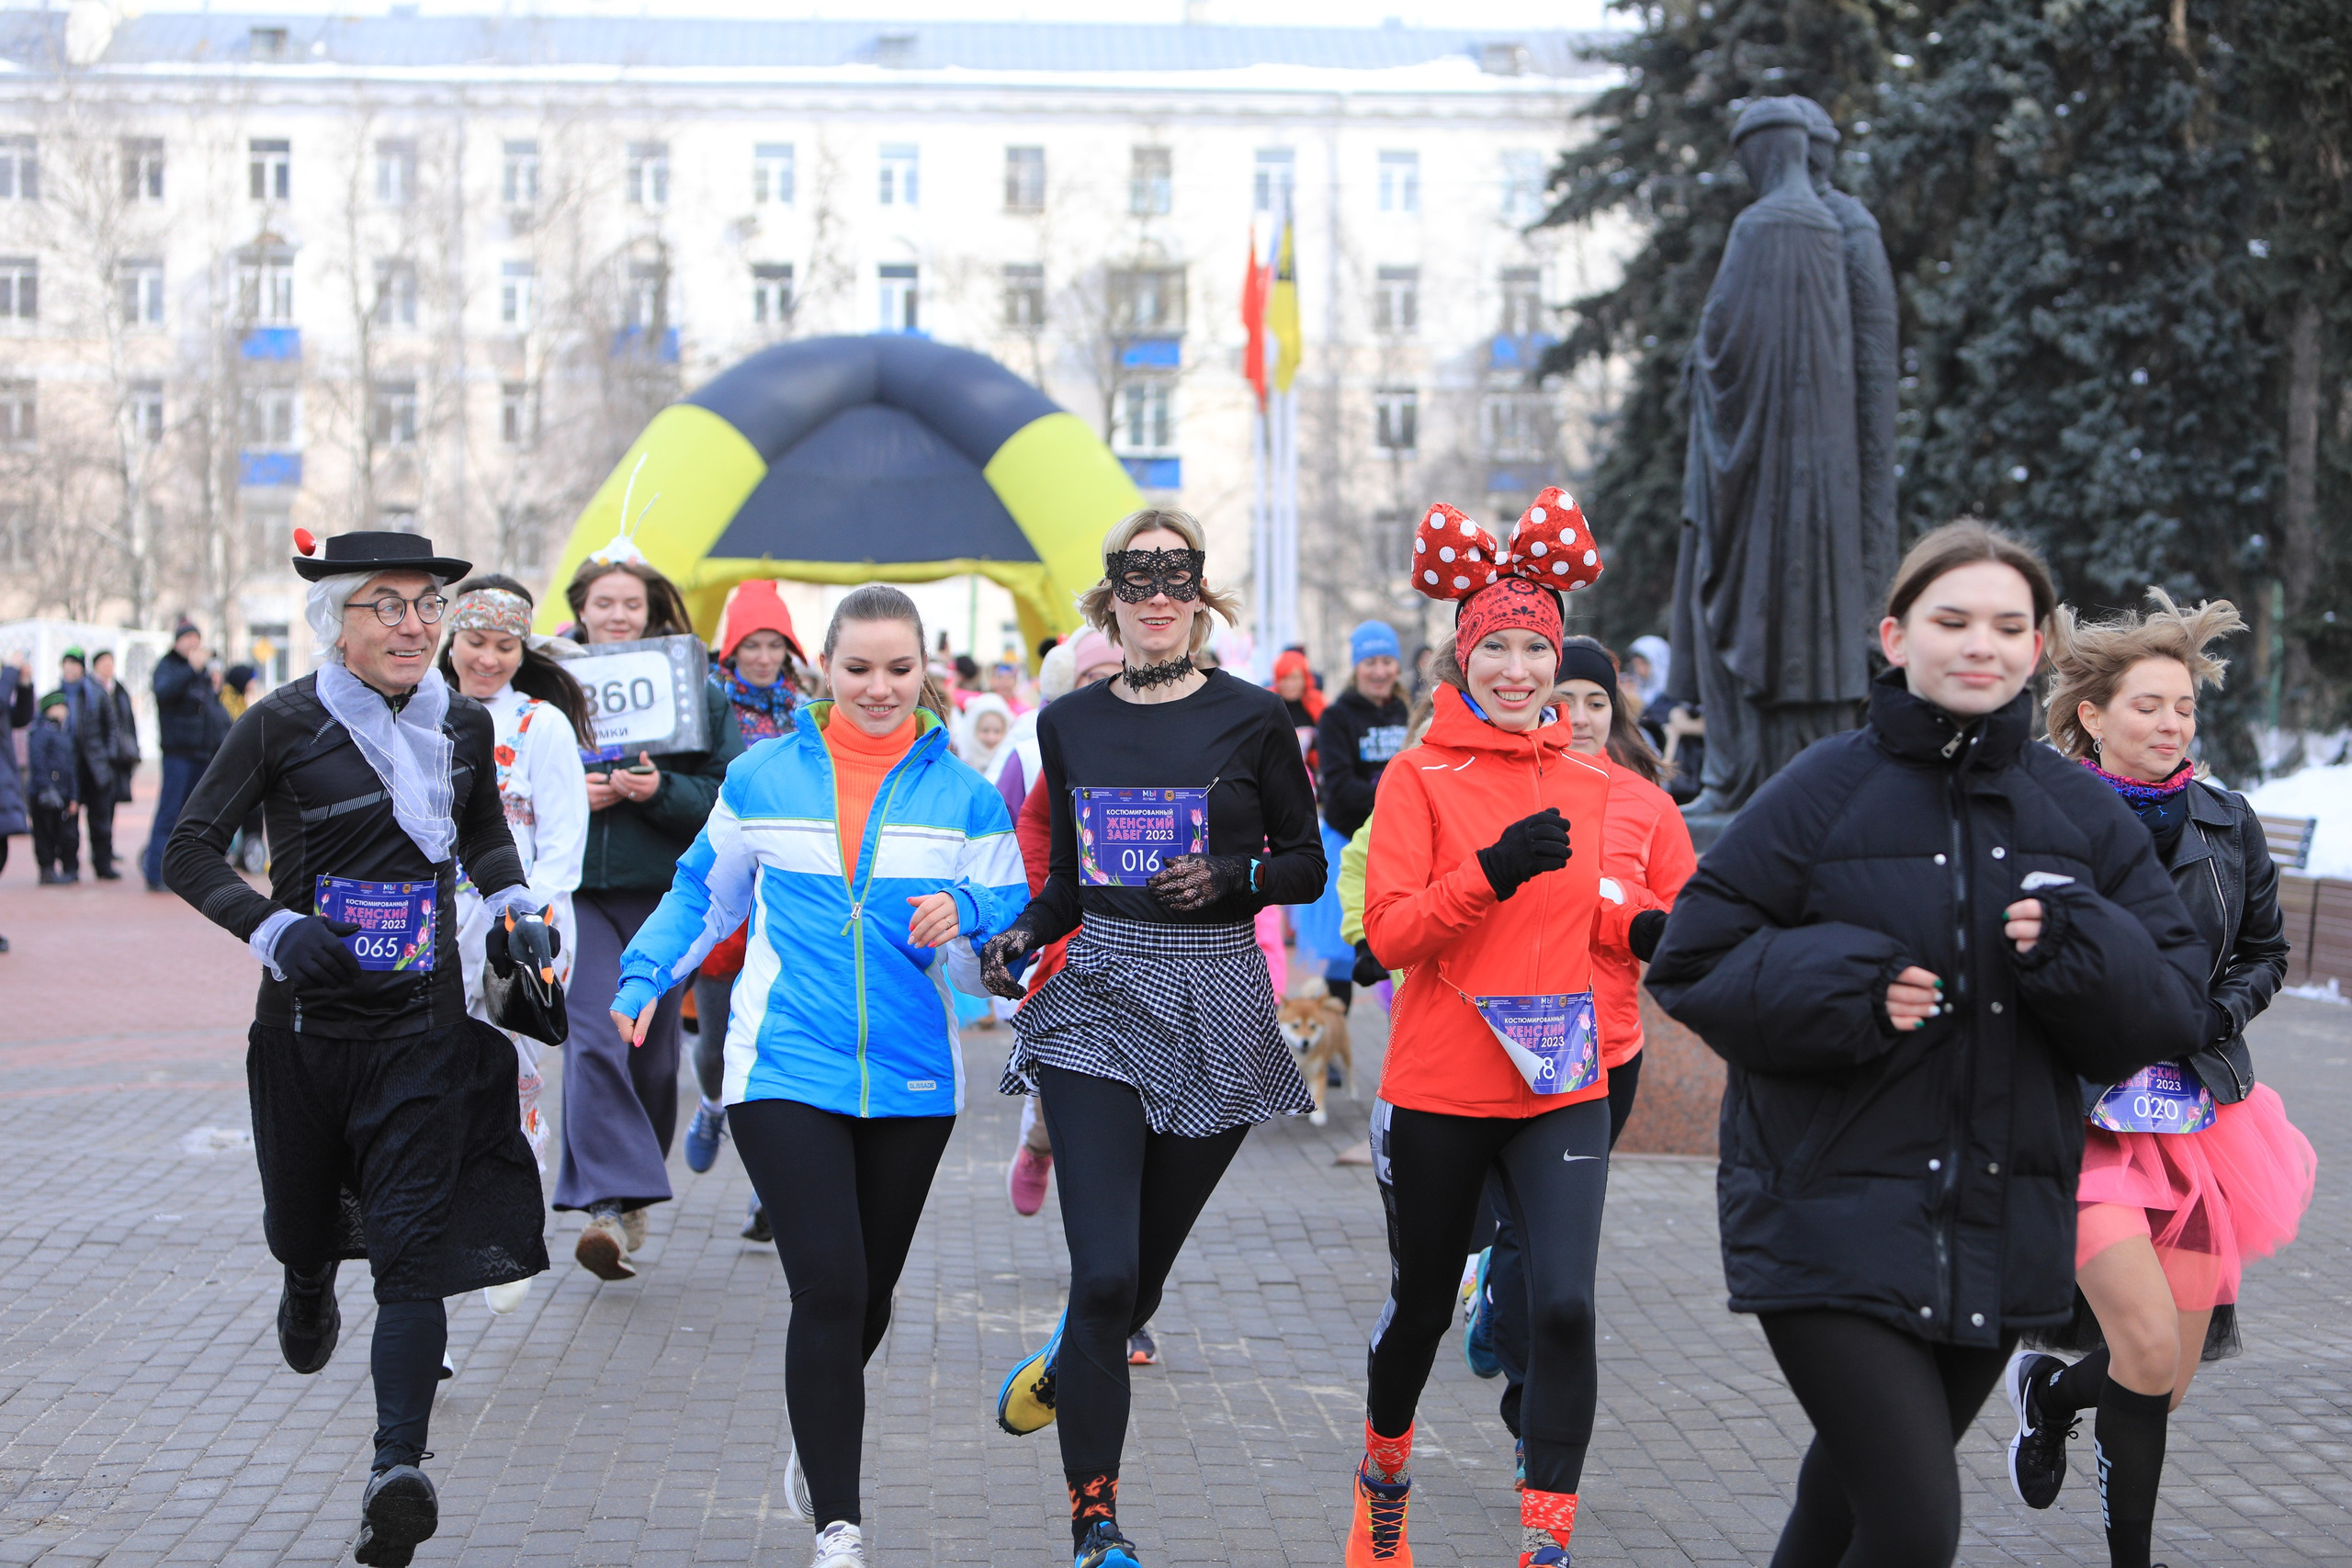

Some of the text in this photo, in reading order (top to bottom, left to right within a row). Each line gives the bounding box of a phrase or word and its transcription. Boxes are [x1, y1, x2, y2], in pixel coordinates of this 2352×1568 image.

[1106, 816, 1174, 829] ЖЕНСКИЙ
[1106, 829, 1174, 840] ЗАБЕГ 2023
[1122, 849, 1160, 872] 016
[345, 898, 408, 907] КОСТЮМИРОВАННЫЙ
[344, 906, 408, 919] ЖЕНСКИЙ
[380, 919, 406, 930] 2023
[355, 936, 398, 957] 065
[1505, 1015, 1565, 1023] КОСТЮМИРОВАННЫЙ
[1505, 1021, 1565, 1037] ЖЕНСКИЙ
[1541, 1036, 1565, 1047] 2023
[2156, 1078, 2181, 1091] 2023
[2133, 1096, 2178, 1120] 020
